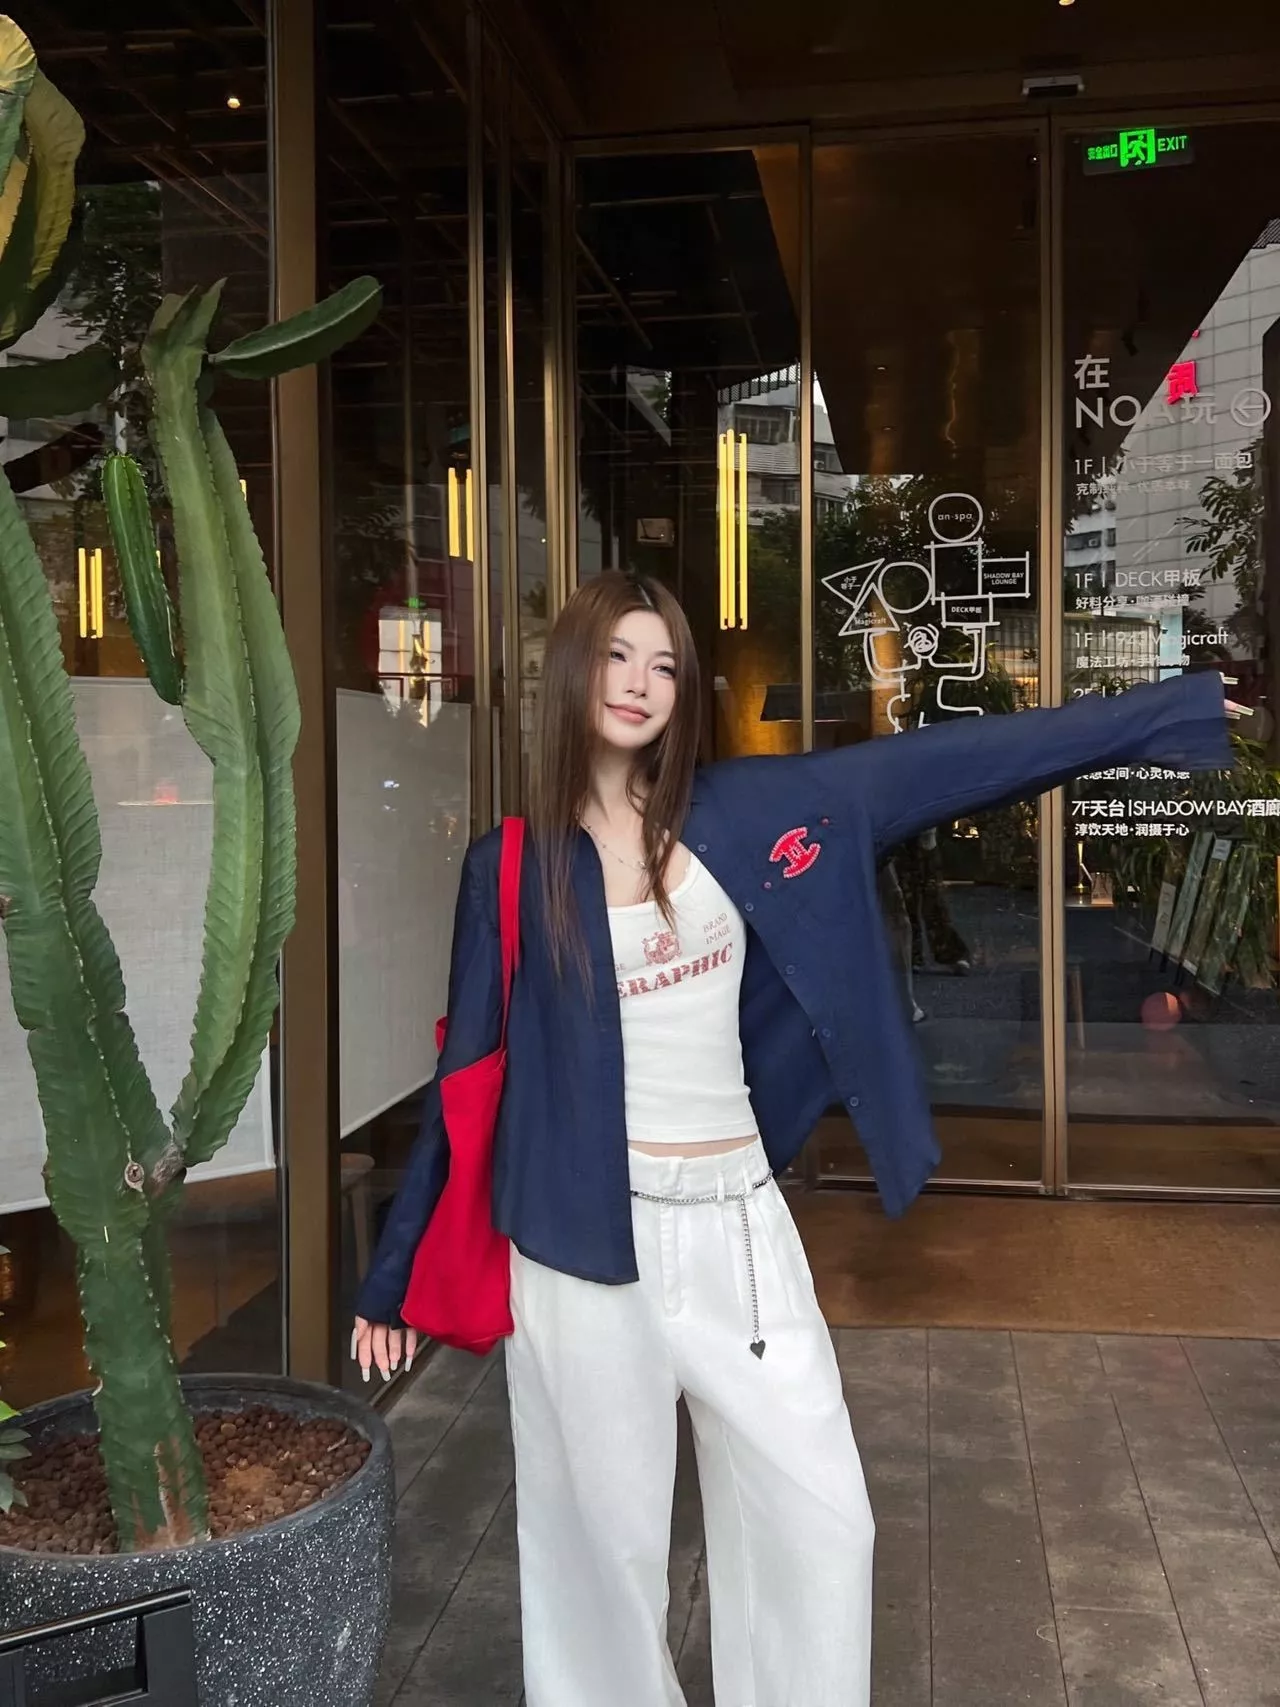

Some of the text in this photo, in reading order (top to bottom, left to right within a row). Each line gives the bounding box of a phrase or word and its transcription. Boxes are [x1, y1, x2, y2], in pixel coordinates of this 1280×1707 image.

[1158, 135, 1188, 152] EXIT
[1074, 354, 1110, 390] 在
[1074, 458, 1093, 475] 1F
[1074, 573, 1094, 588] 1F
[1115, 568, 1202, 588] DECK甲板
[1074, 632, 1094, 648] 1F
[1075, 655, 1191, 669] 魔法工坊·手作物
[1076, 767, 1191, 780] 想空间·心灵休
[703, 912, 728, 934] BRAND
